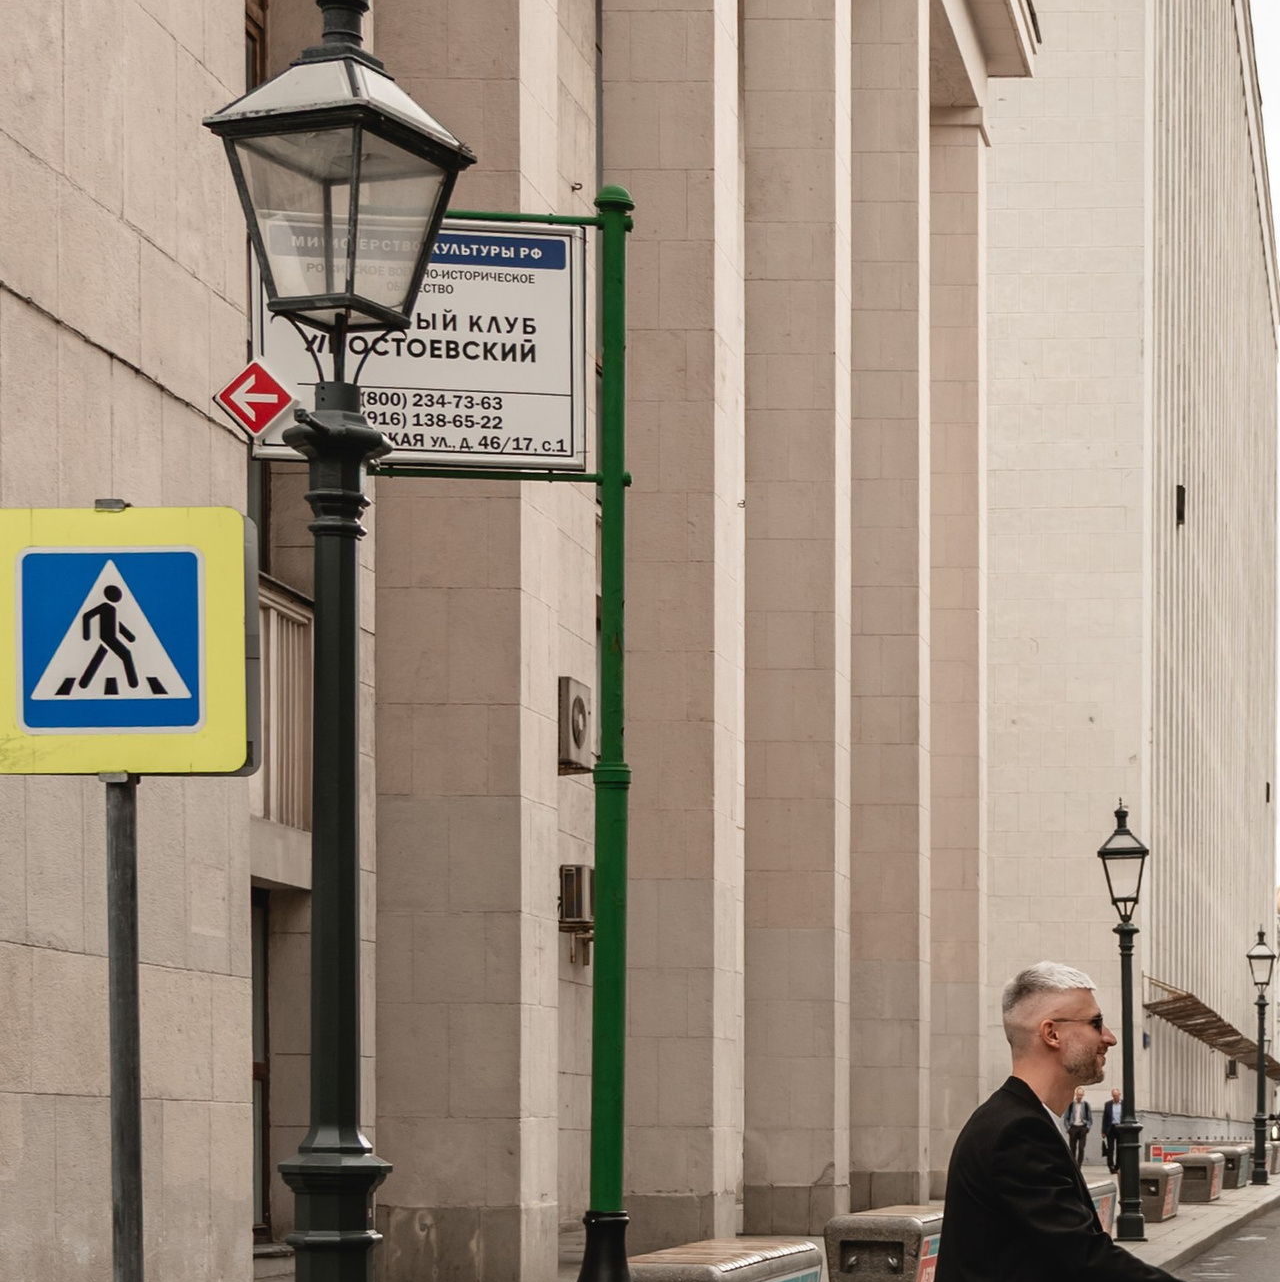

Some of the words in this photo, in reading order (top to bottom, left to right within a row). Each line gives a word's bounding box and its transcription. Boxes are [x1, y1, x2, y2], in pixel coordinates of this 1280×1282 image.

[291, 235, 421, 252] МИИСЕРСТВО
[432, 243, 515, 258] КУЛЬТУРЫ
[520, 247, 542, 260] РФ
[469, 315, 537, 335] КЛУБ
[412, 393, 503, 410] 234-73-63
[412, 413, 503, 430] 138-65-22
[478, 435, 538, 453] 46/17,
